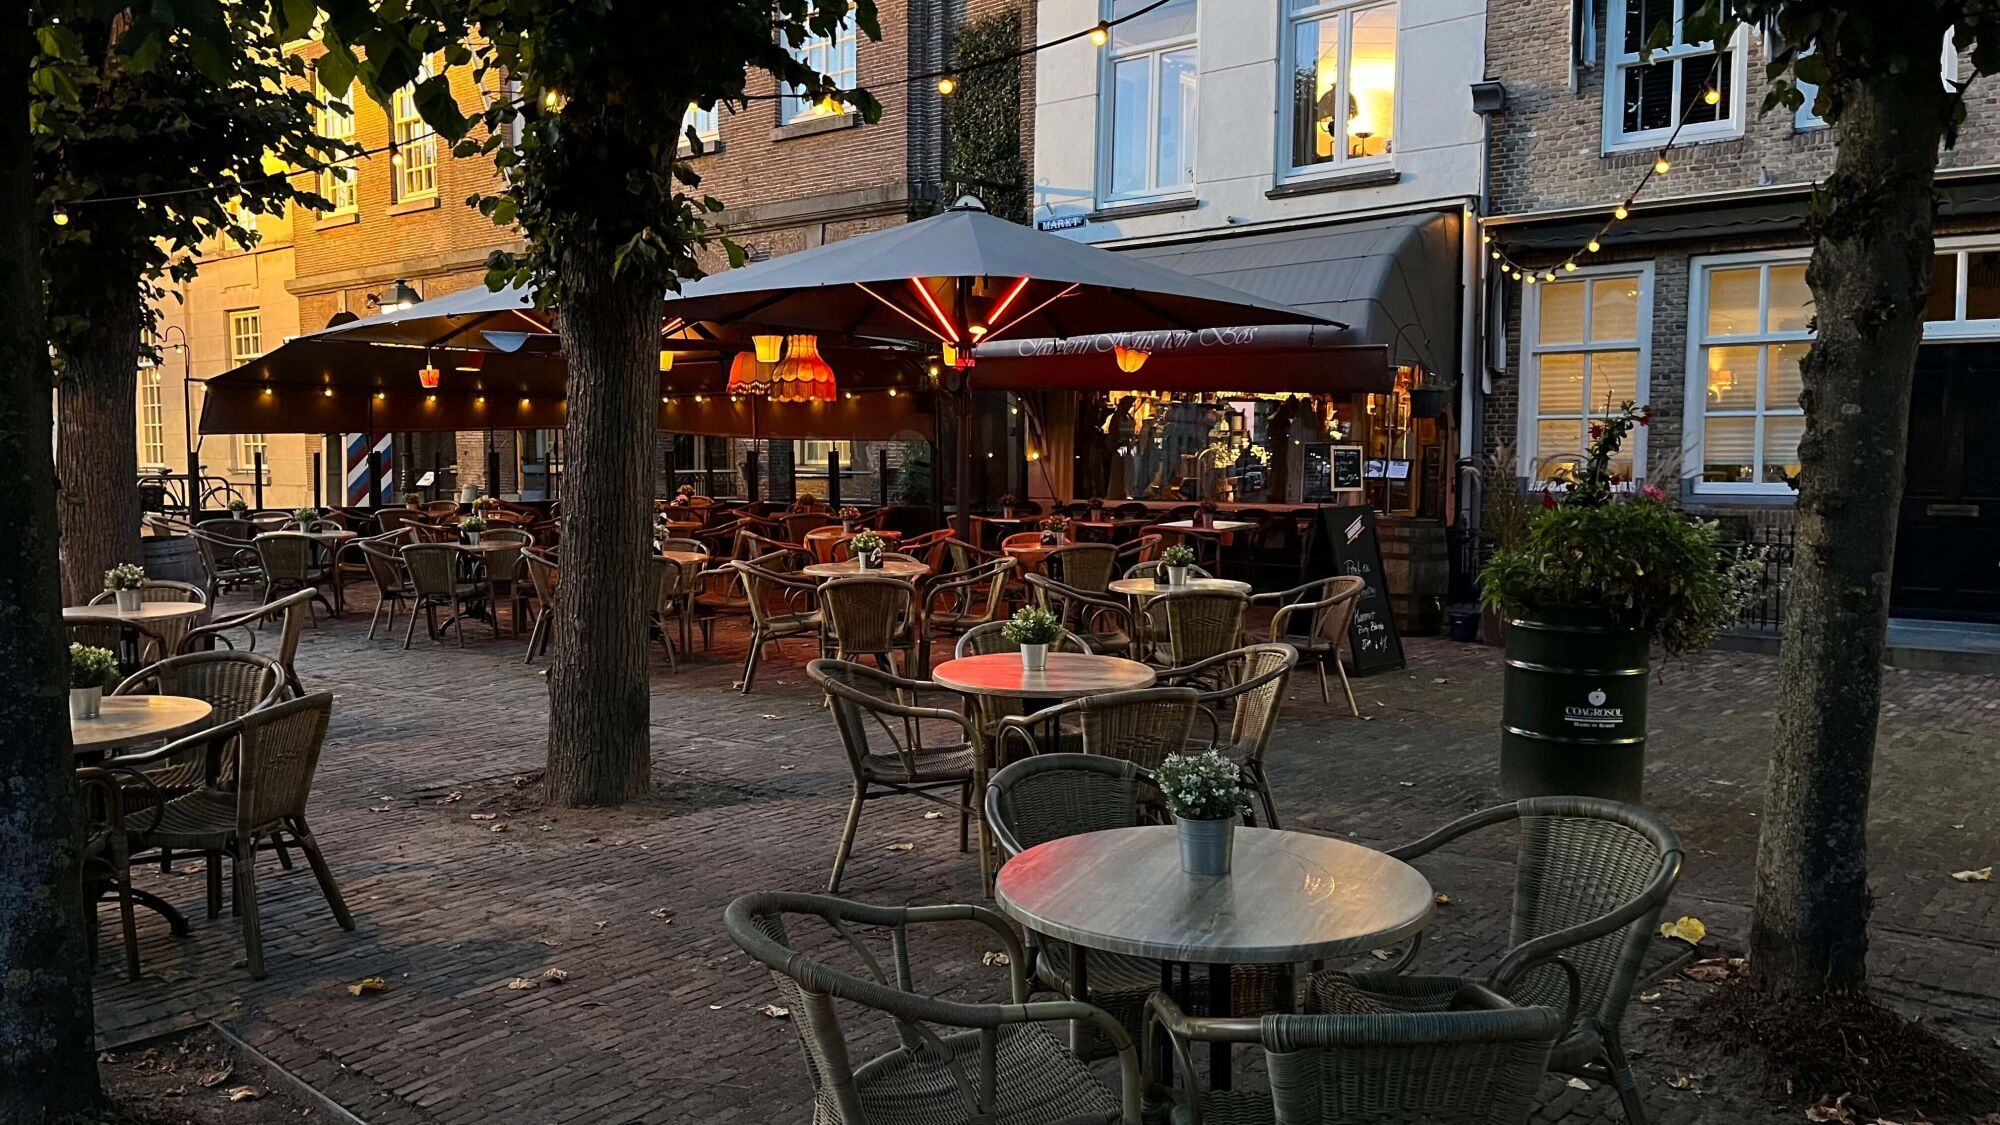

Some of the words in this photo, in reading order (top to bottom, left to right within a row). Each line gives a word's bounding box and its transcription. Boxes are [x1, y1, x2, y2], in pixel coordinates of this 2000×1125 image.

[1042, 217, 1080, 231] MARKT
[1199, 325, 1258, 346] Bos
[1565, 706, 1623, 717] COAGROSOL
